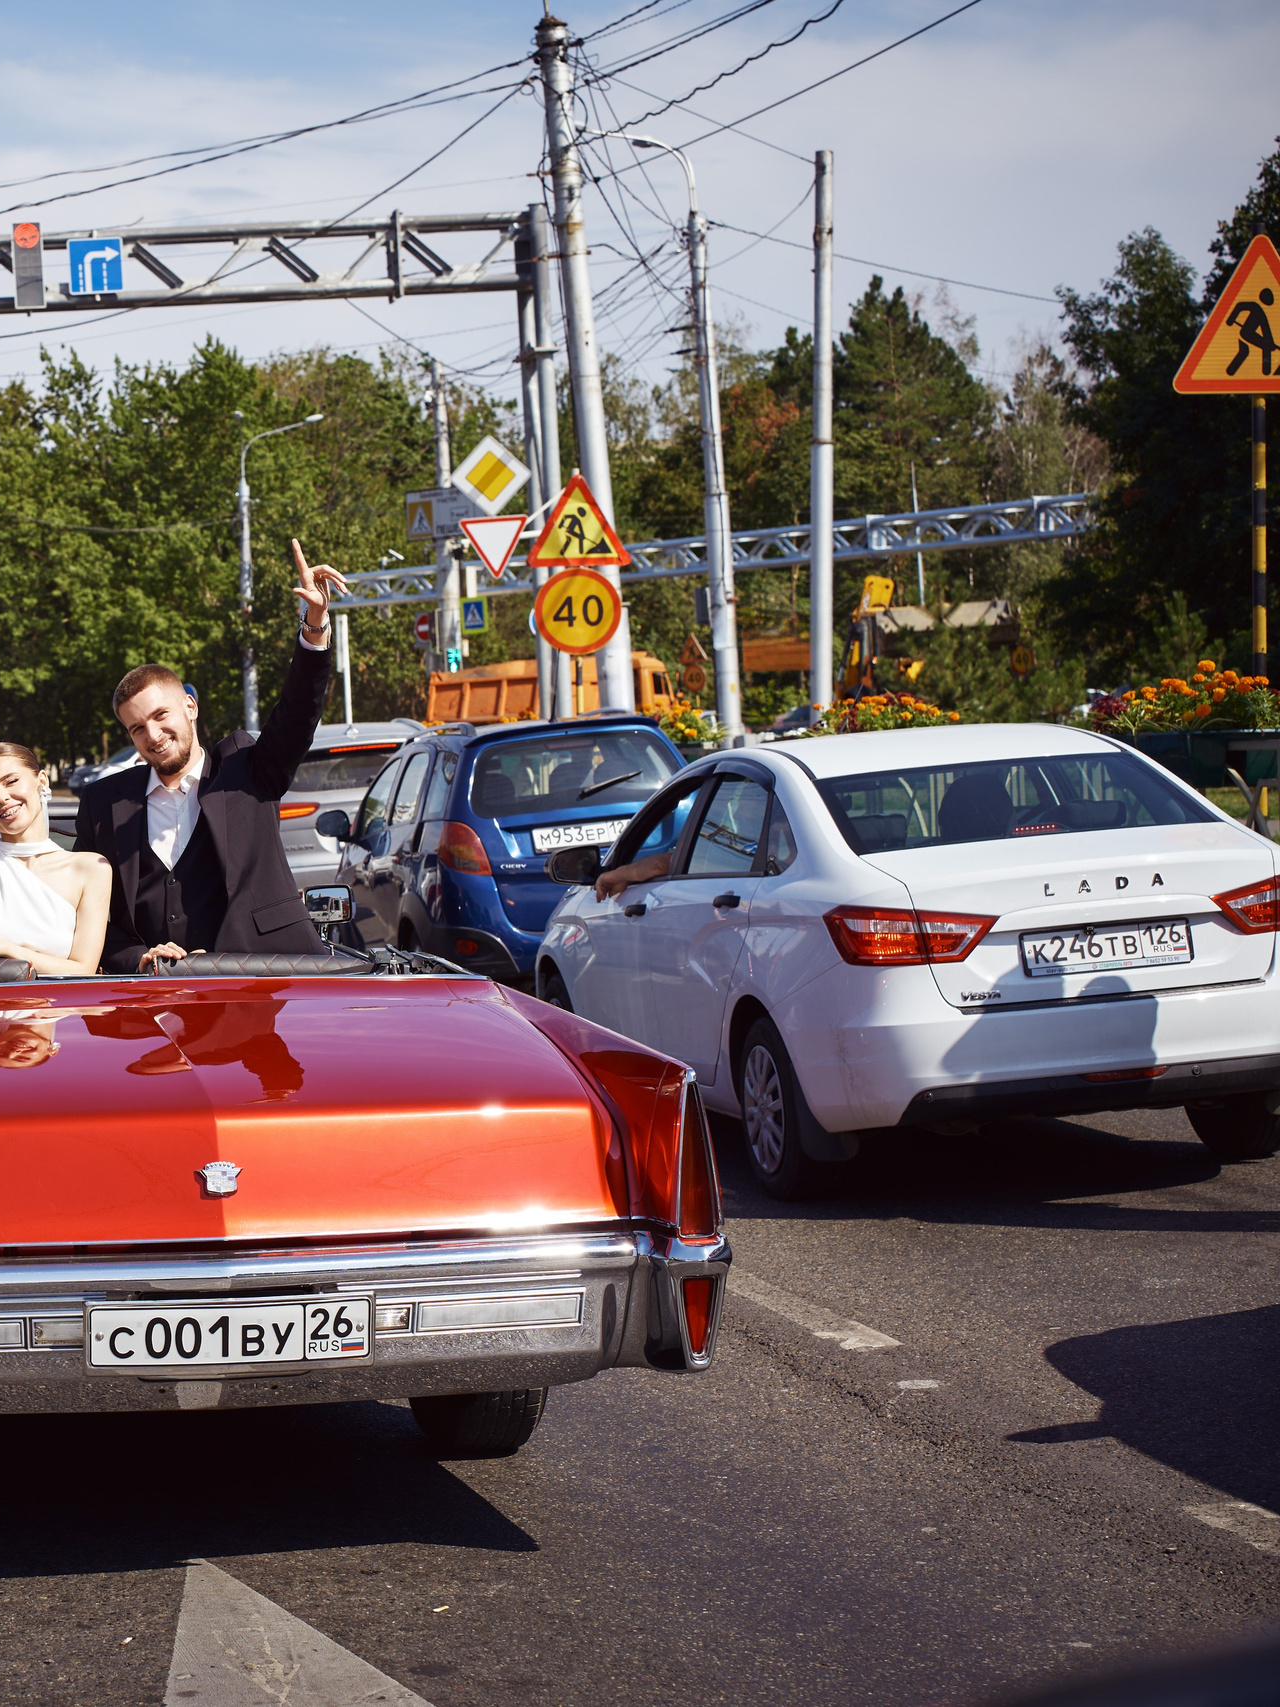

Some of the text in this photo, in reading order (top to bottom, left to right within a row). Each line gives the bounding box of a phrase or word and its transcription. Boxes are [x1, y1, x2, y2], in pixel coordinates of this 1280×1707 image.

[553, 594, 604, 627] 40
[688, 671, 702, 684] 40
[540, 820, 631, 846] М953ЕР 12
[1044, 873, 1164, 897] LADA
[1032, 923, 1182, 965] К246ТВ 126
[1153, 944, 1173, 953] RUS
[961, 990, 1001, 1002] VESTA
[109, 1305, 354, 1359] С001ВУ 26
[308, 1340, 340, 1354] RUS
